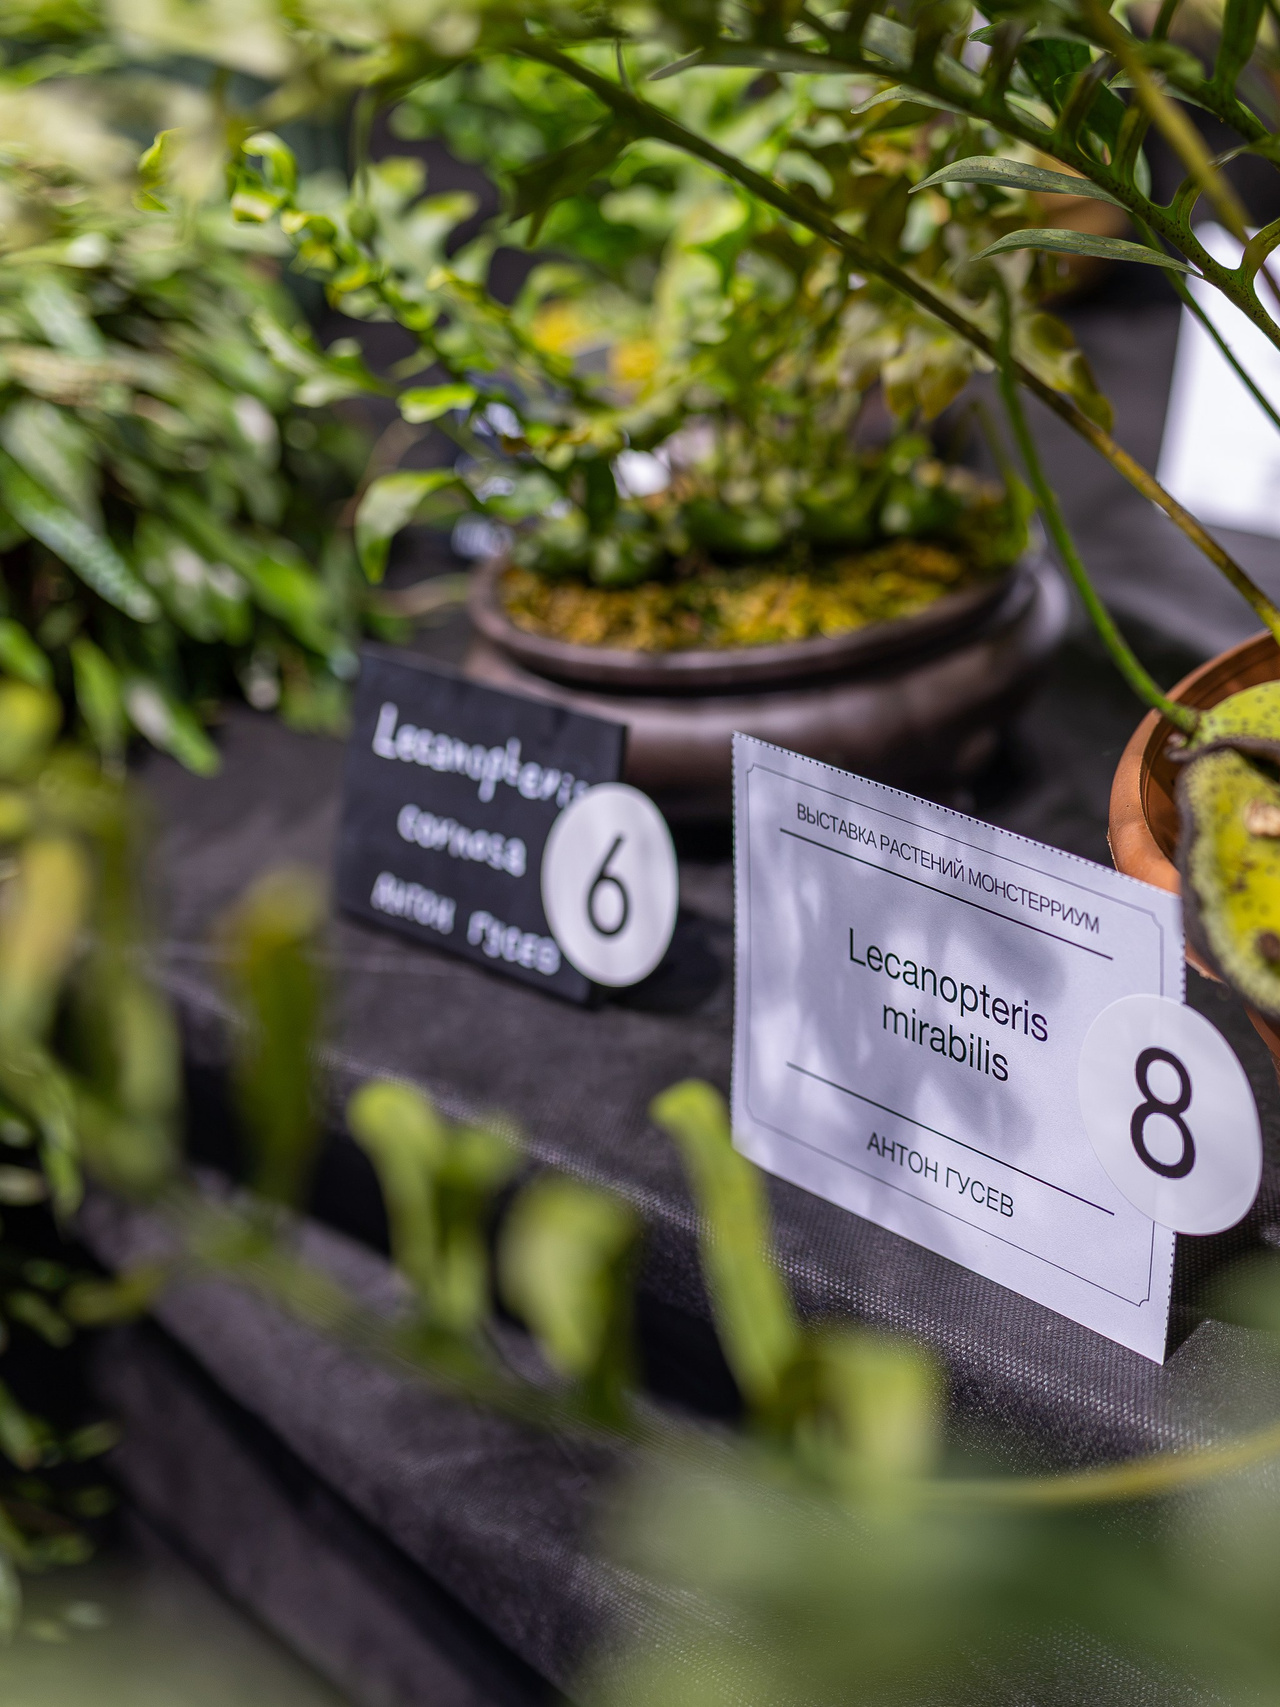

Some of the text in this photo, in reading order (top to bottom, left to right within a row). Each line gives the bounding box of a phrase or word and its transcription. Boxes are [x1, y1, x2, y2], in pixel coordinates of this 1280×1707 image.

[587, 834, 630, 937] 6
[796, 803, 1100, 934] ВЫСТАВКА РАСТЕНИЙ МОНСТЕРРИУМ
[850, 927, 1048, 1042] Lecanopteris
[883, 1004, 1009, 1081] mirabilis
[1130, 1046, 1196, 1180] 8
[867, 1131, 1014, 1218] АНТОН ГУСЕВ
